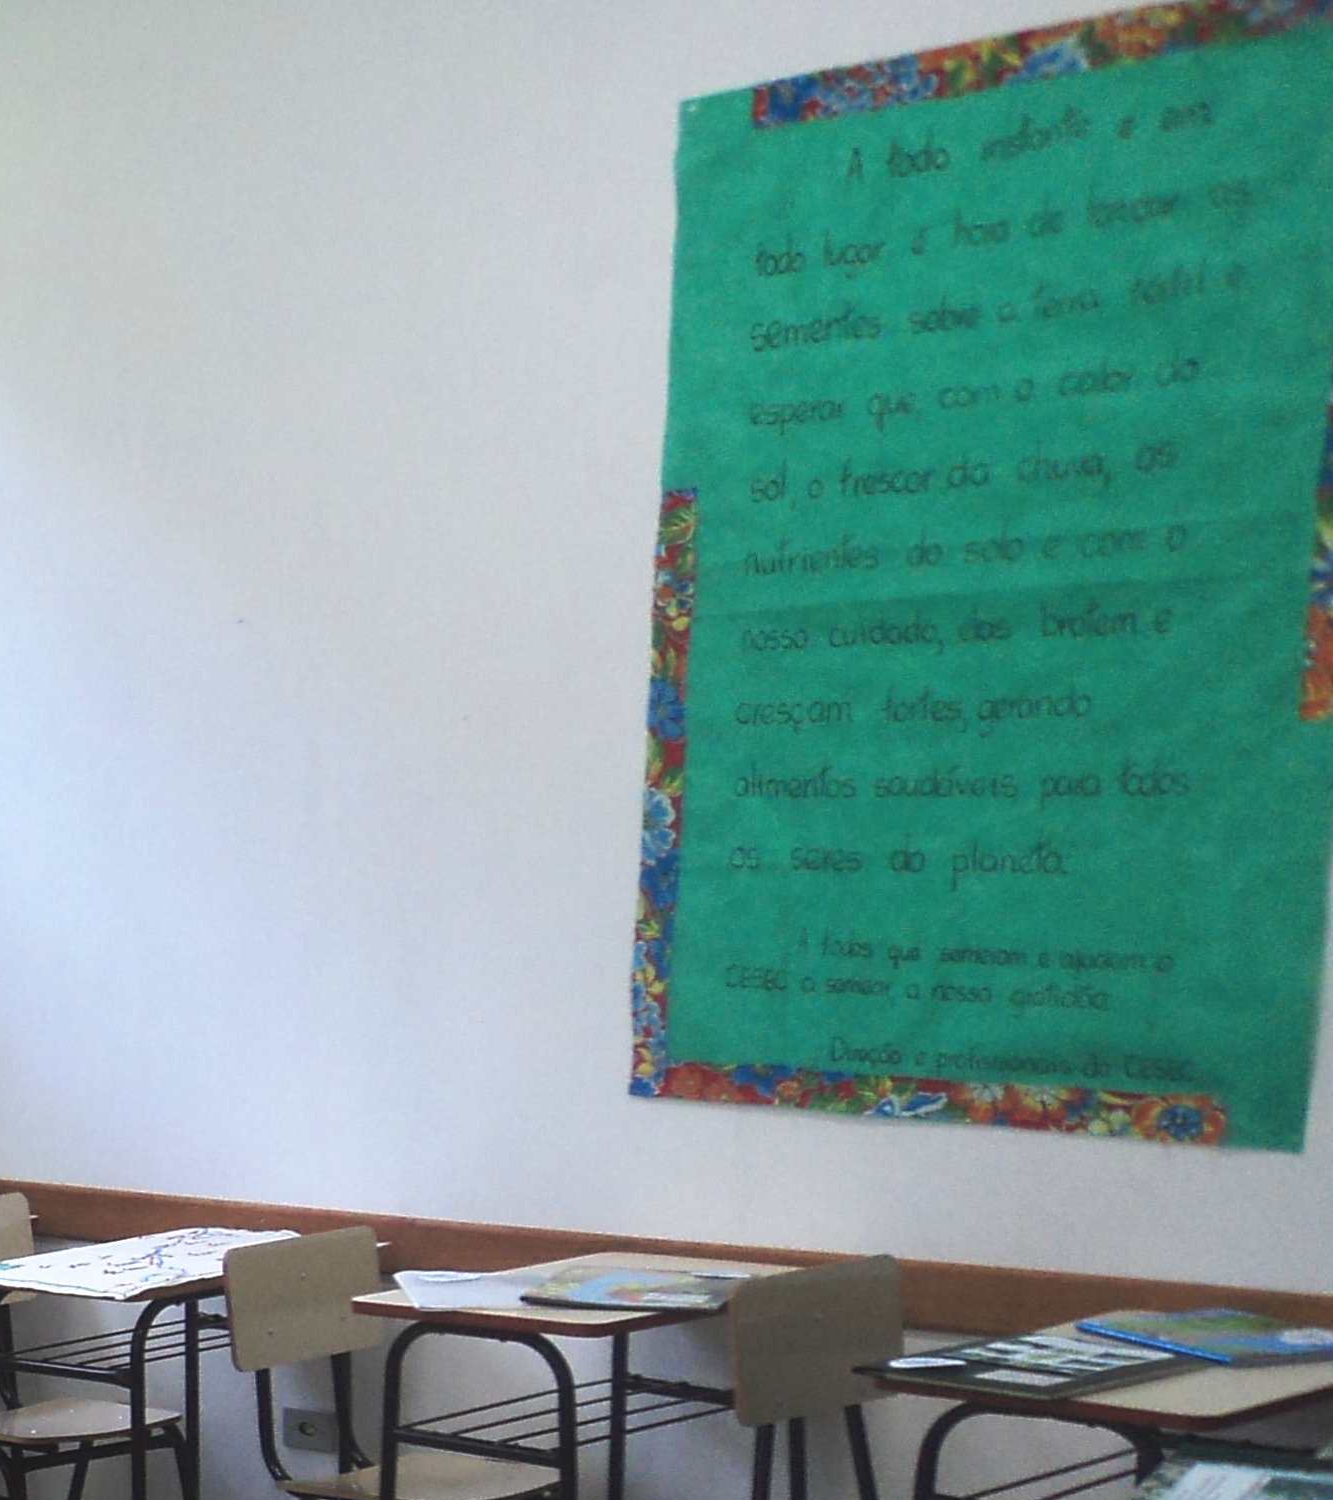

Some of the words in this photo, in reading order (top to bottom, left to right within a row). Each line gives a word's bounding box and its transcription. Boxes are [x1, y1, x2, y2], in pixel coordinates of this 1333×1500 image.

[886, 131, 950, 178] todo
[755, 233, 806, 278] todo
[822, 222, 886, 283] lugar
[952, 201, 1010, 249] hora
[749, 298, 883, 352] sementes
[909, 290, 980, 334] sobre
[996, 301, 1017, 323] a
[747, 397, 845, 437] esperar
[937, 381, 1000, 409] com
[1013, 378, 1035, 402] o
[1057, 361, 1133, 397] calor
[1157, 348, 1201, 386] do
[807, 479, 823, 500] o
[839, 451, 935, 498] frescor
[947, 454, 990, 489] da
[744, 532, 881, 577] nutrientes
[906, 531, 944, 567] do
[963, 520, 1024, 564] solo
[1041, 533, 1061, 559] e
[1164, 522, 1188, 553] o
[740, 626, 806, 652] nosso
[1039, 597, 1138, 638] brotem
[1153, 607, 1173, 634] e
[733, 697, 854, 734] cresçam
[976, 687, 1092, 737] gerando
[733, 761, 856, 801] alimentos
[874, 763, 1018, 801] saudáveis
[1039, 772, 1102, 810] para
[1117, 761, 1192, 797] todos
[730, 846, 759, 870] os
[789, 846, 862, 872] seres
[888, 837, 926, 873] do
[887, 944, 921, 971] que
[905, 979, 920, 1000] a
[930, 980, 992, 1003] nossa
